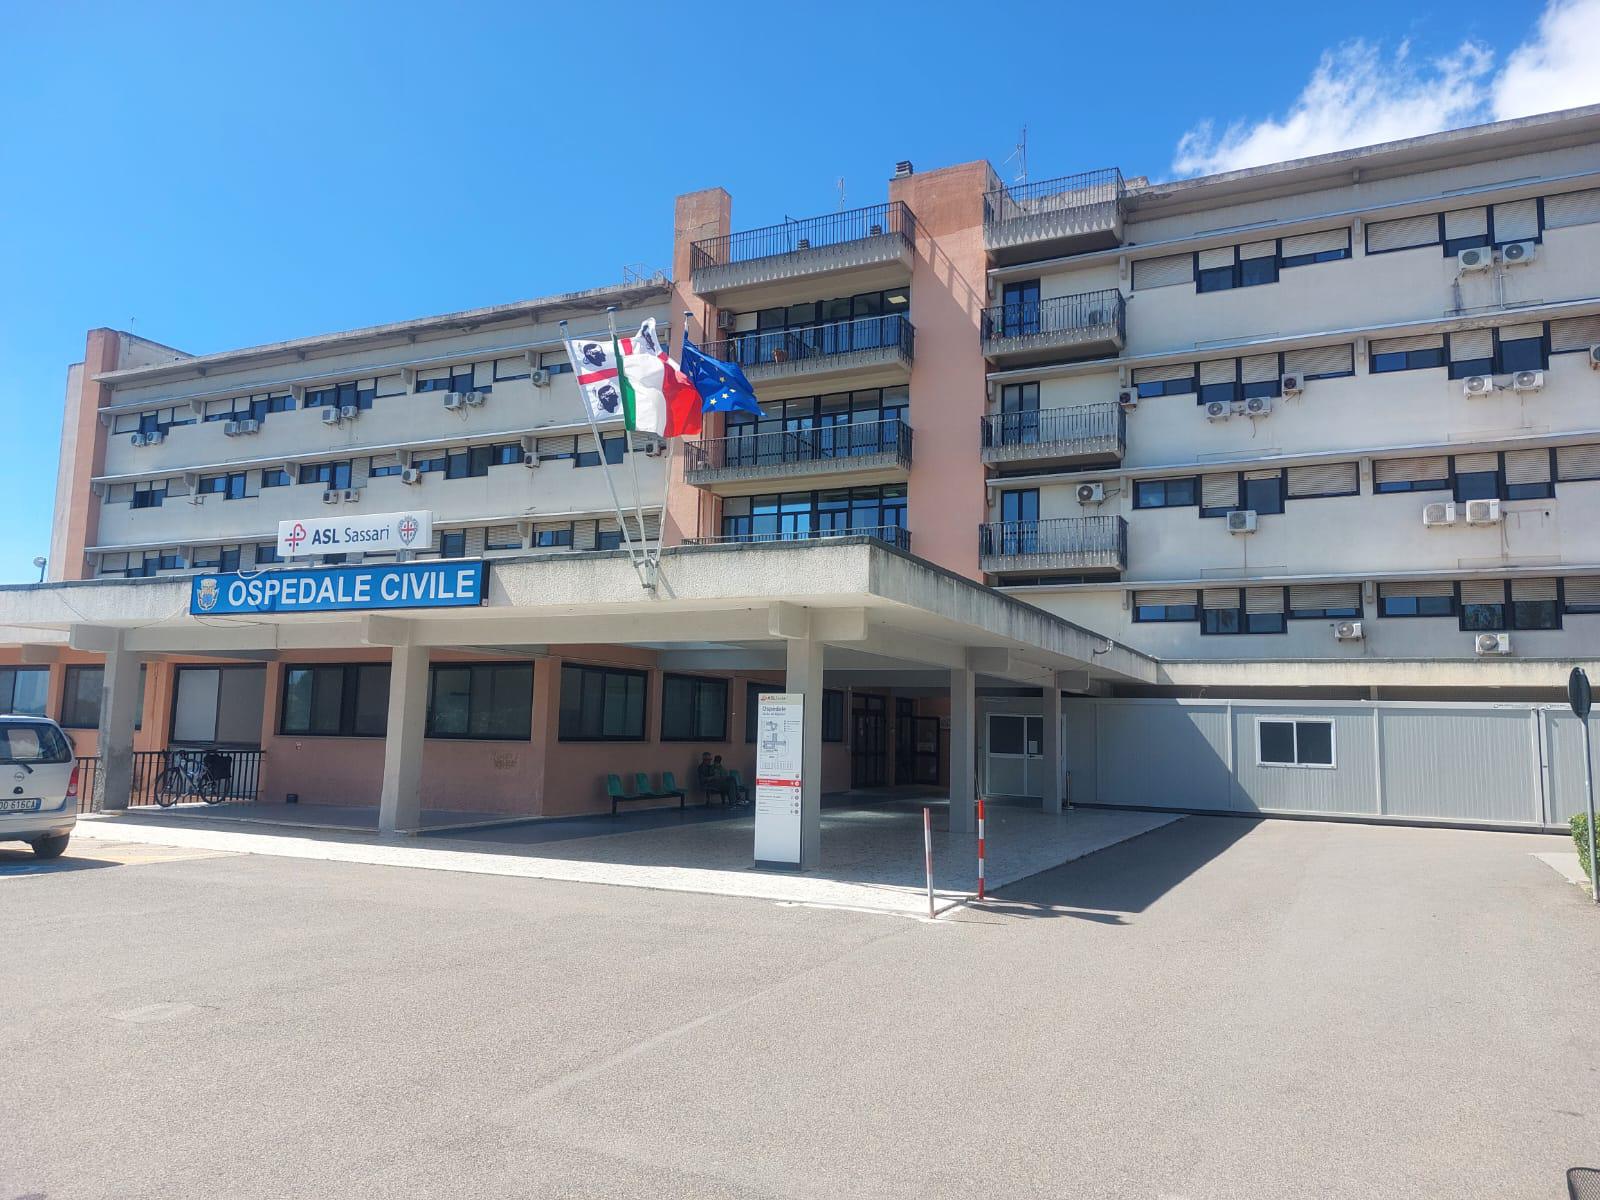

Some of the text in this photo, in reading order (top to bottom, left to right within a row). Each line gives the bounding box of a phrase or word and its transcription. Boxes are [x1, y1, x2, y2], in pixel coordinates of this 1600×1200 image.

[311, 525, 390, 545] ASL Sassari
[228, 570, 475, 606] OSPEDALE CIVILE
